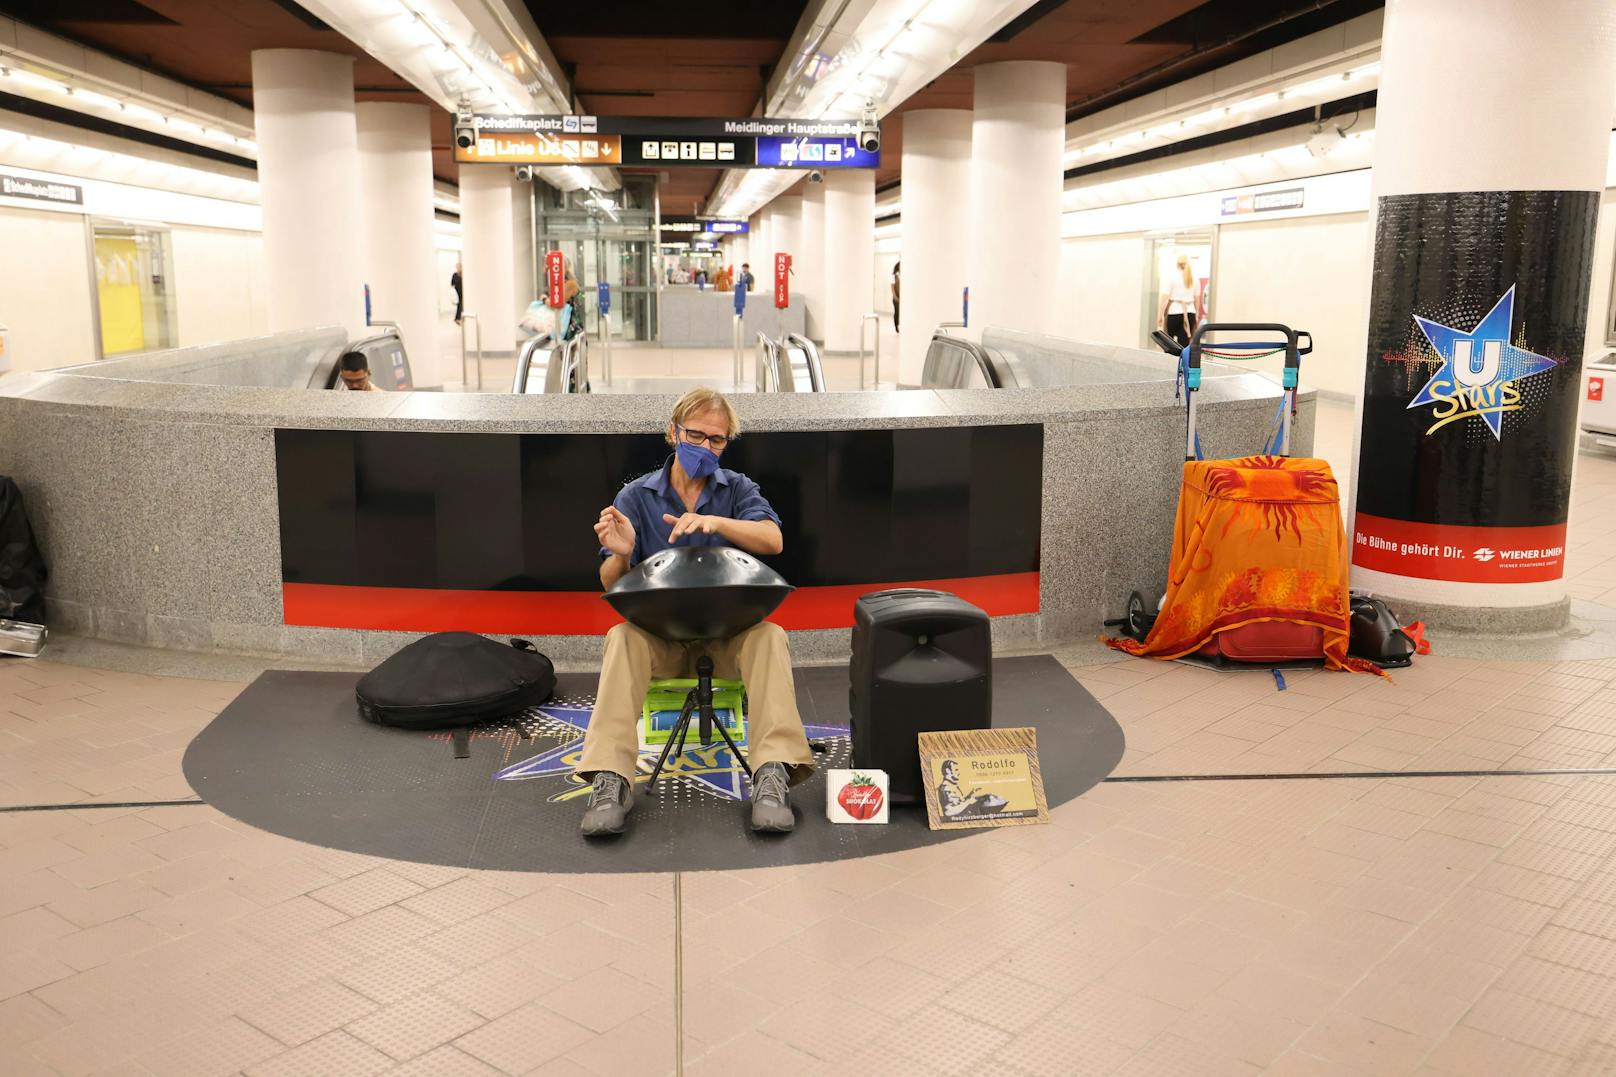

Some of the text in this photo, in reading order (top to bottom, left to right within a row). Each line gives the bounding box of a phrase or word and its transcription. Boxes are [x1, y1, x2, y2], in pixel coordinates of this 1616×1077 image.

[474, 117, 562, 131] Schedifkaplatz
[725, 121, 862, 136] Meidlinger Hauptstraße
[497, 140, 534, 155] Linie
[1453, 340, 1503, 388] U
[1428, 379, 1521, 419] Stars
[1356, 532, 1465, 559] Die Bühne gehört Dir.
[1500, 546, 1563, 559] WIENER LINIEN
[971, 760, 1015, 770] Rodolfo
